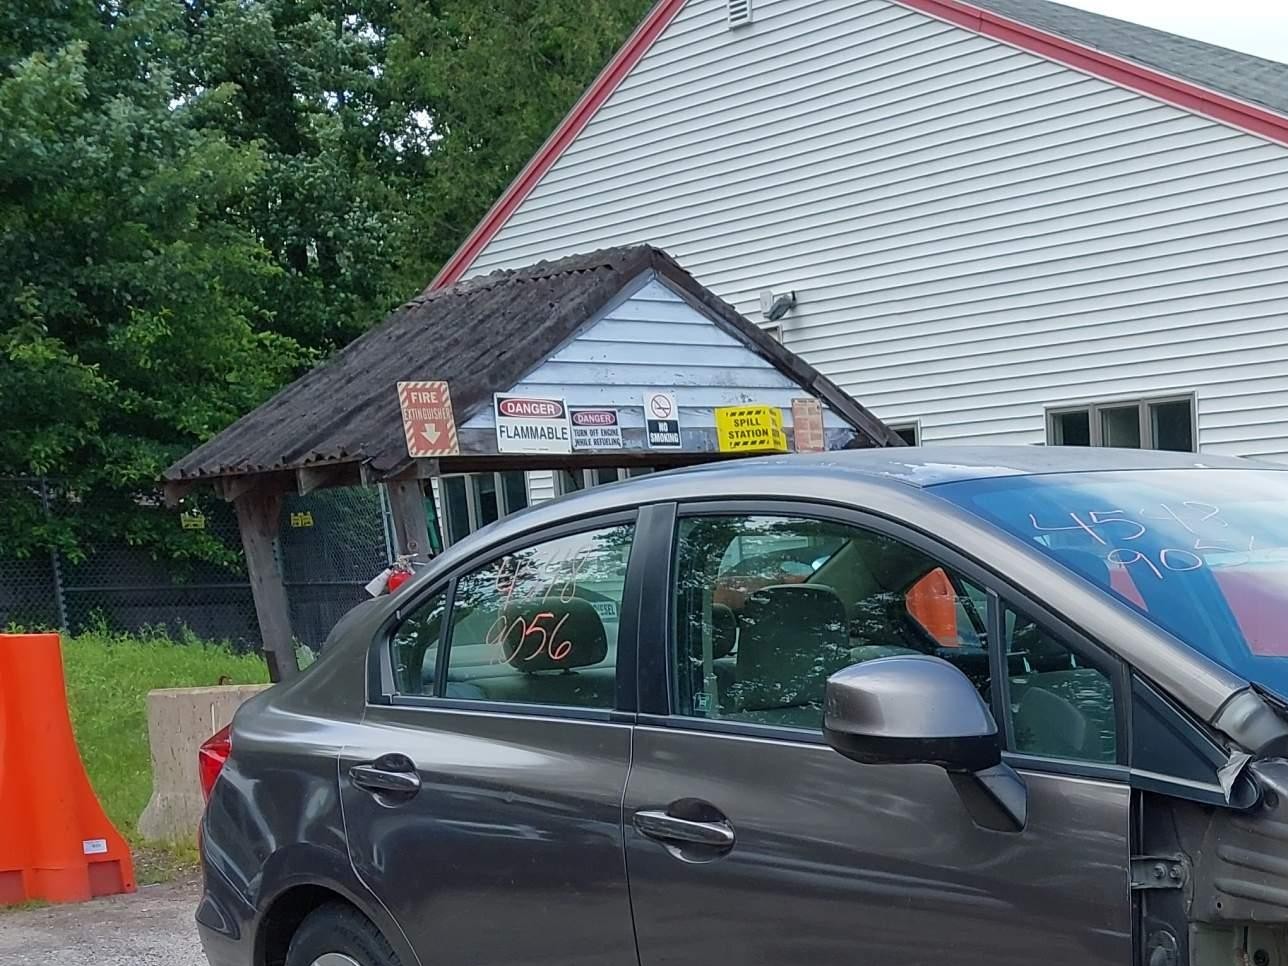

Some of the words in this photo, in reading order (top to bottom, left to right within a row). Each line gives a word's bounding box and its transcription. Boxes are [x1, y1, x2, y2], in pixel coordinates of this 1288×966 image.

[410, 392, 438, 404] FIRE
[507, 402, 556, 415] DANGER
[403, 407, 451, 422] EXTINGUISHER
[577, 414, 611, 424] DANGER
[657, 421, 669, 432] NO
[733, 418, 761, 428] SPILL
[499, 425, 569, 441] FLAMMABLE
[574, 428, 588, 437] TURN
[589, 428, 599, 437] OFF
[600, 428, 619, 436] ENGINE
[650, 432, 679, 443] SMOKING
[728, 428, 769, 440] STATION
[575, 438, 593, 447] WHILE
[593, 438, 621, 447] REFUELING
[485, 612, 572, 665] 9056
